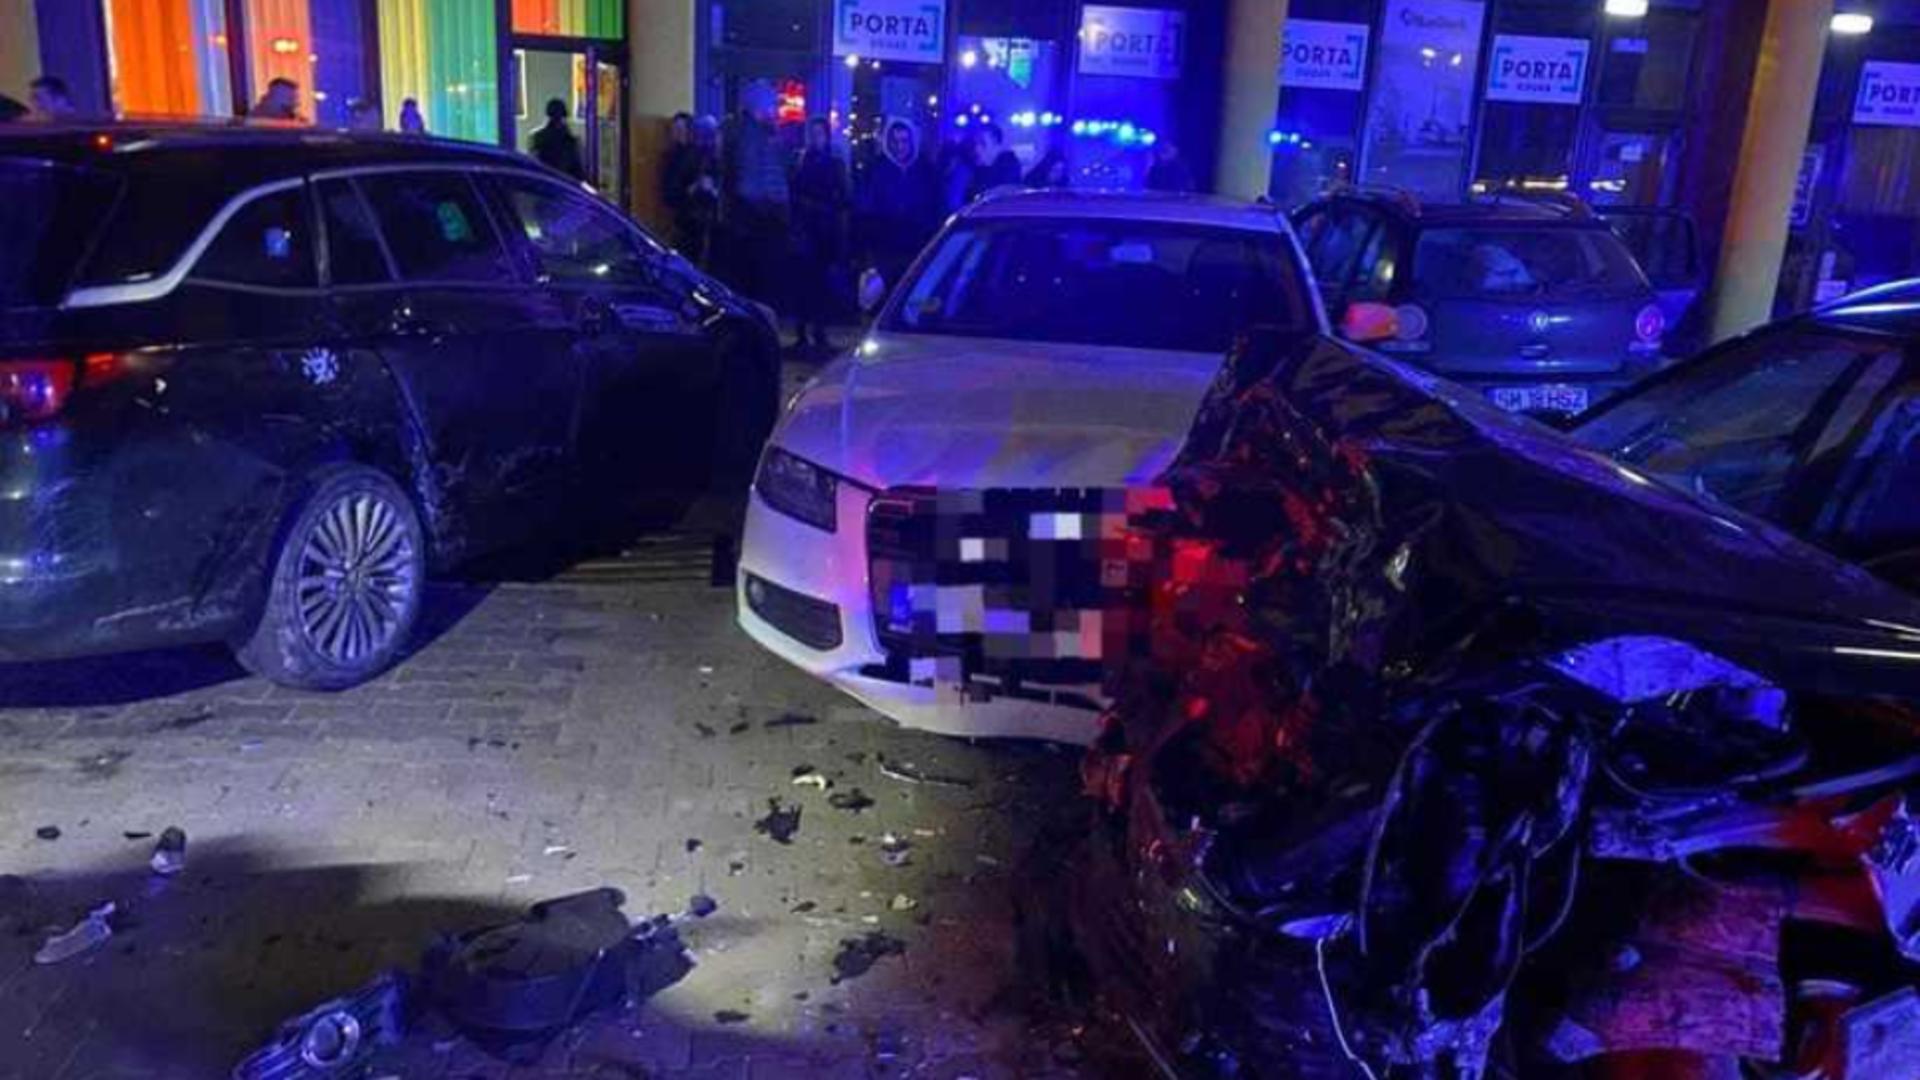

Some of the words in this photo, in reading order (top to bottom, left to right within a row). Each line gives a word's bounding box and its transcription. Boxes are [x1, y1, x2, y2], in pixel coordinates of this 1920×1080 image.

[850, 12, 930, 36] PORTA
[1096, 31, 1172, 55] PORTA
[1281, 41, 1353, 67] PORTA
[1502, 57, 1573, 81] PORTA
